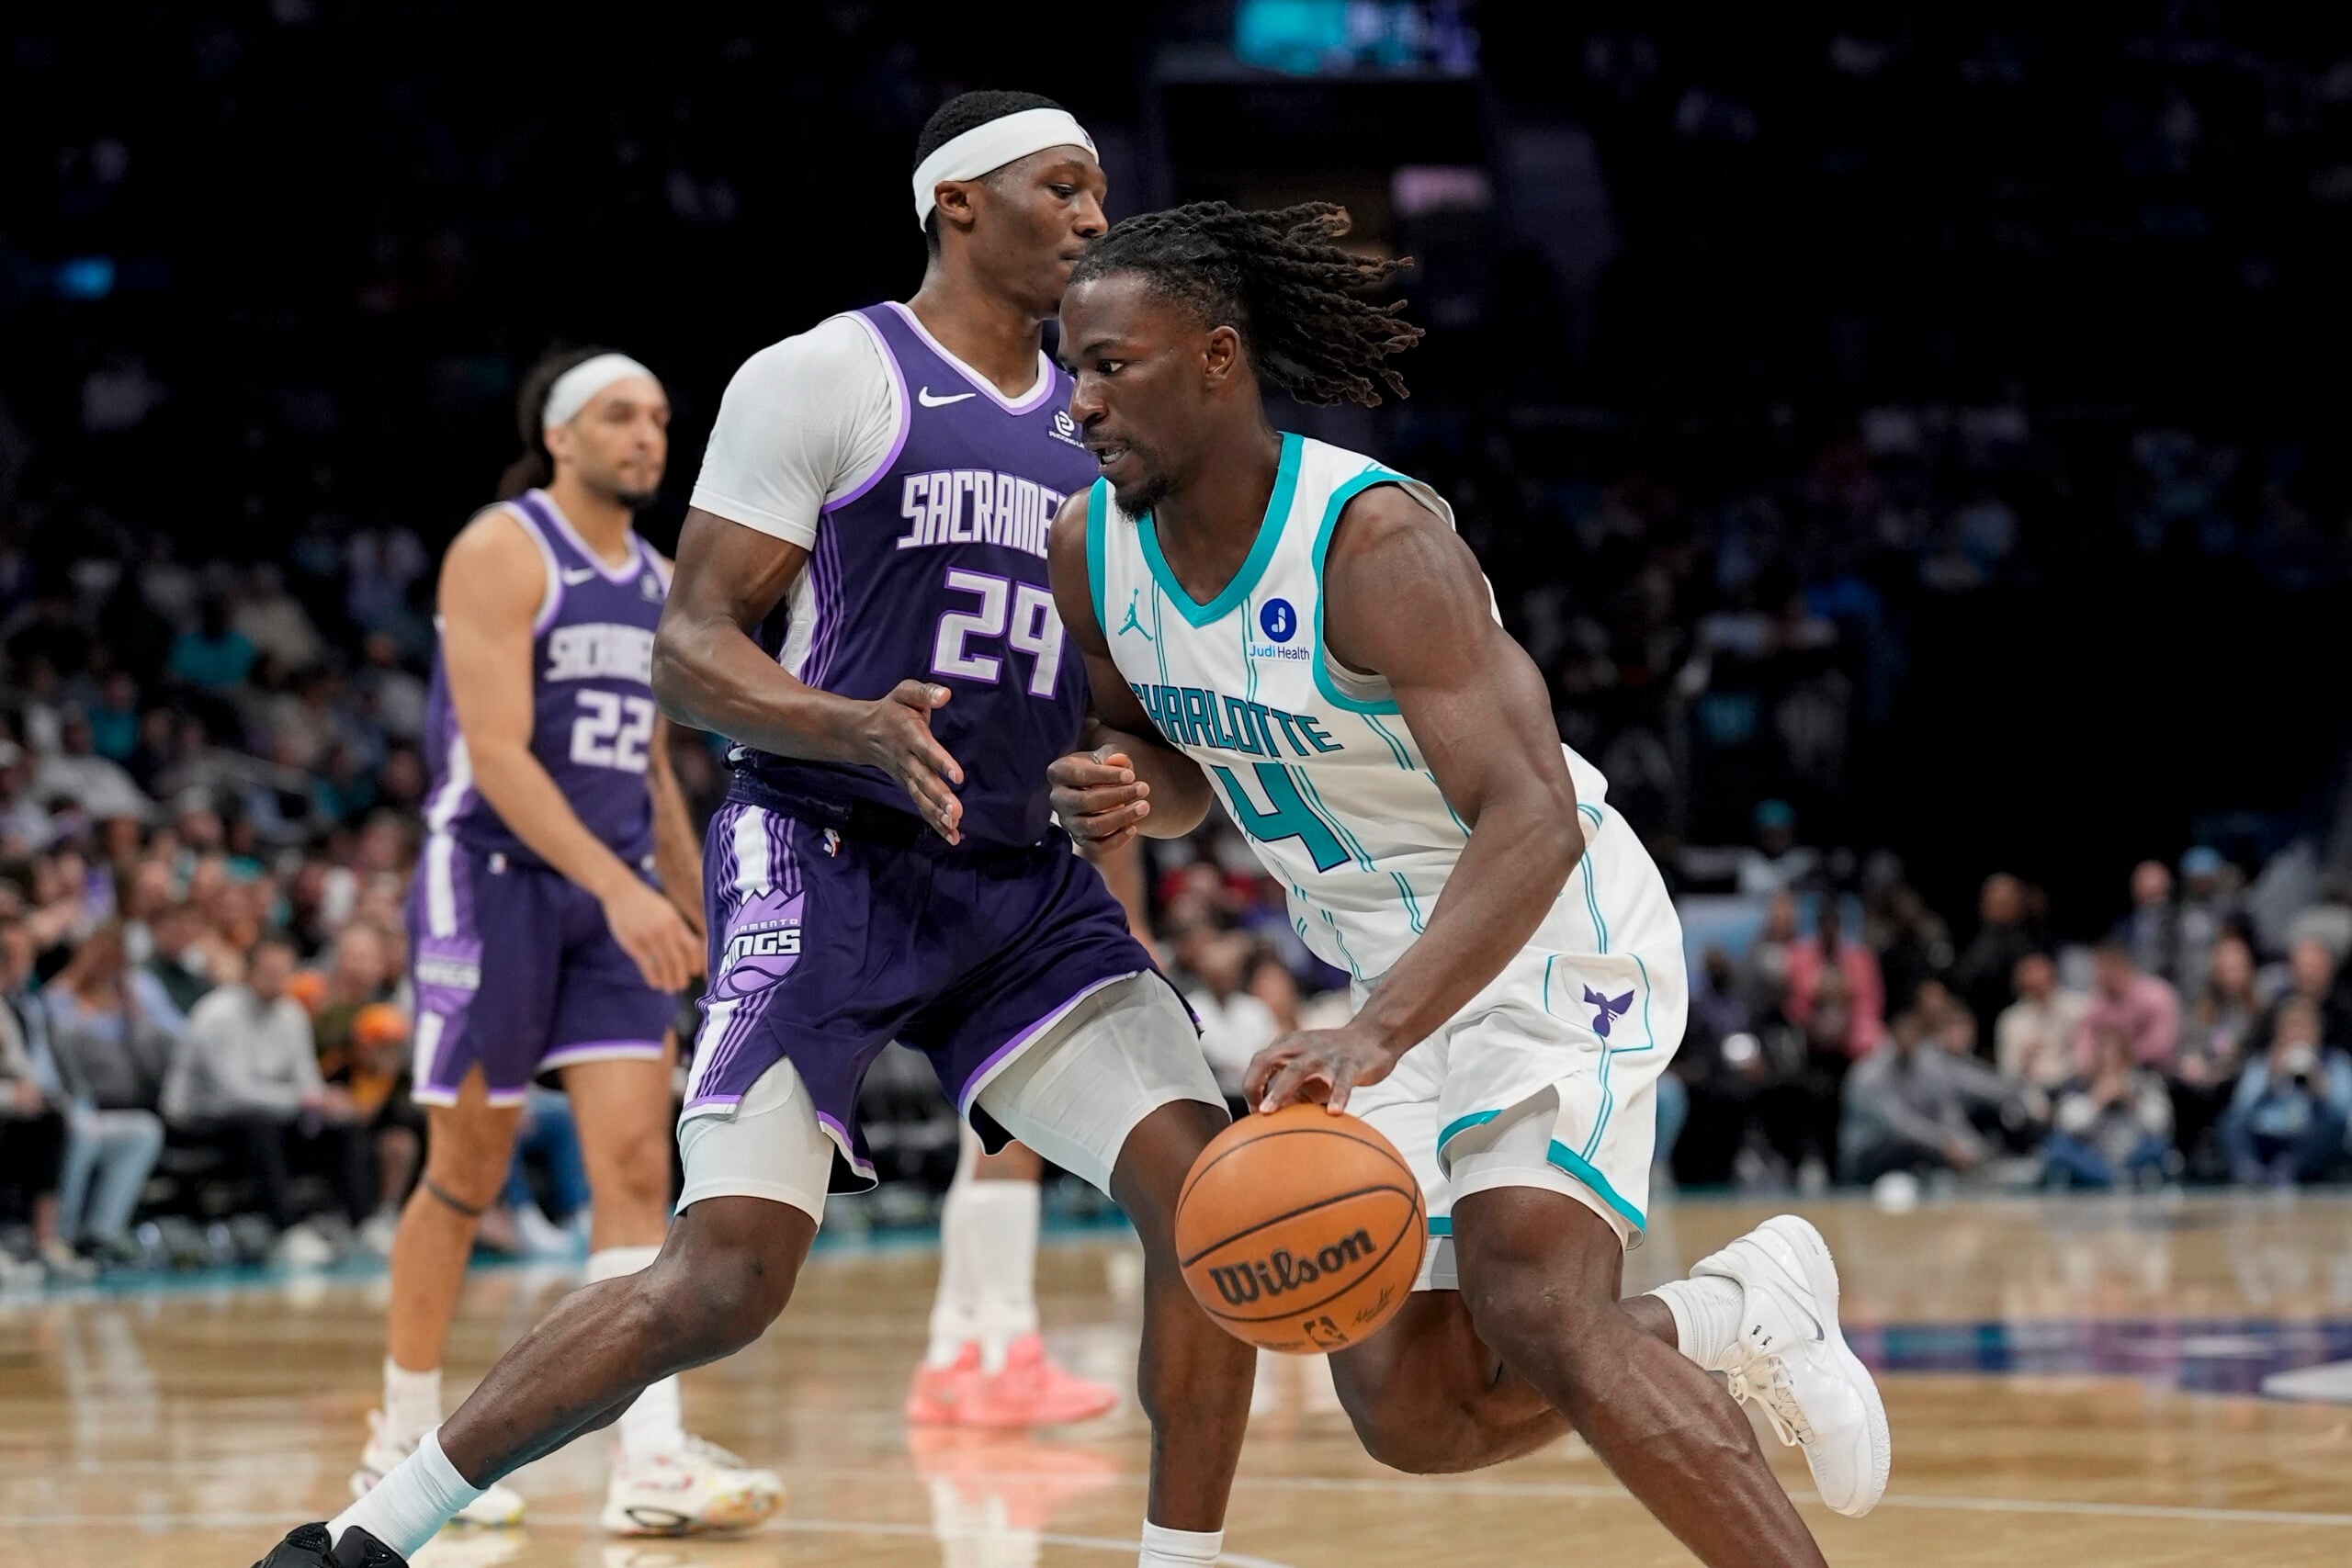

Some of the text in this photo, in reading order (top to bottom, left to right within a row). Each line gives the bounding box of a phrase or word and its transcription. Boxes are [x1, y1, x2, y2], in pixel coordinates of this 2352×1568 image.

[897, 468, 1067, 560] SACRAME
[930, 567, 1067, 700] 29
[1250, 644, 1310, 660] Judi Health
[570, 688, 656, 774] 22
[1210, 761, 1351, 874] 4
[1208, 1227, 1376, 1306] Wilson
